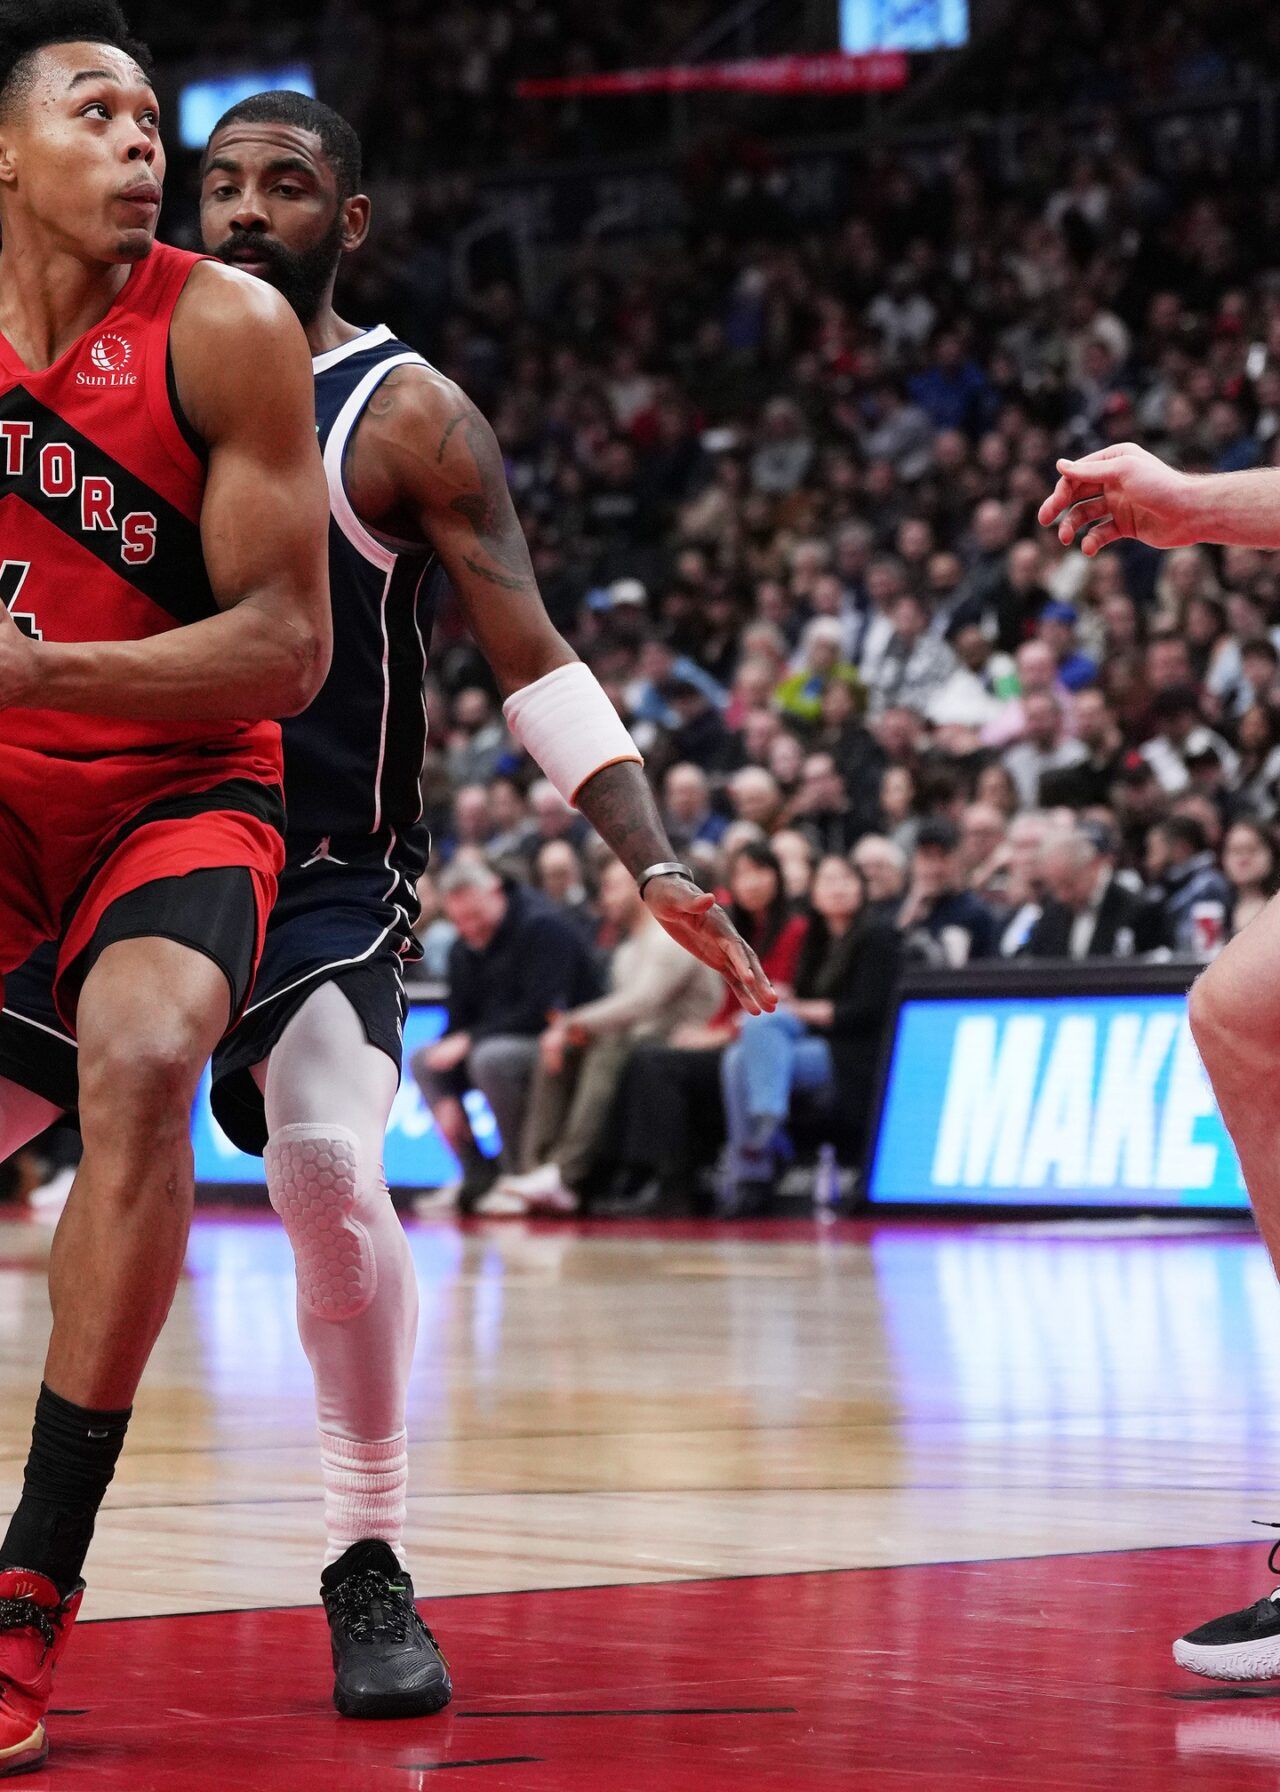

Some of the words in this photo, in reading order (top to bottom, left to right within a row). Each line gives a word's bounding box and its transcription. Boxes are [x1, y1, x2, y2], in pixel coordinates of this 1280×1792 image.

[75, 371, 107, 386] Sun
[110, 371, 138, 386] Life
[931, 1012, 1220, 1189] MAKE
